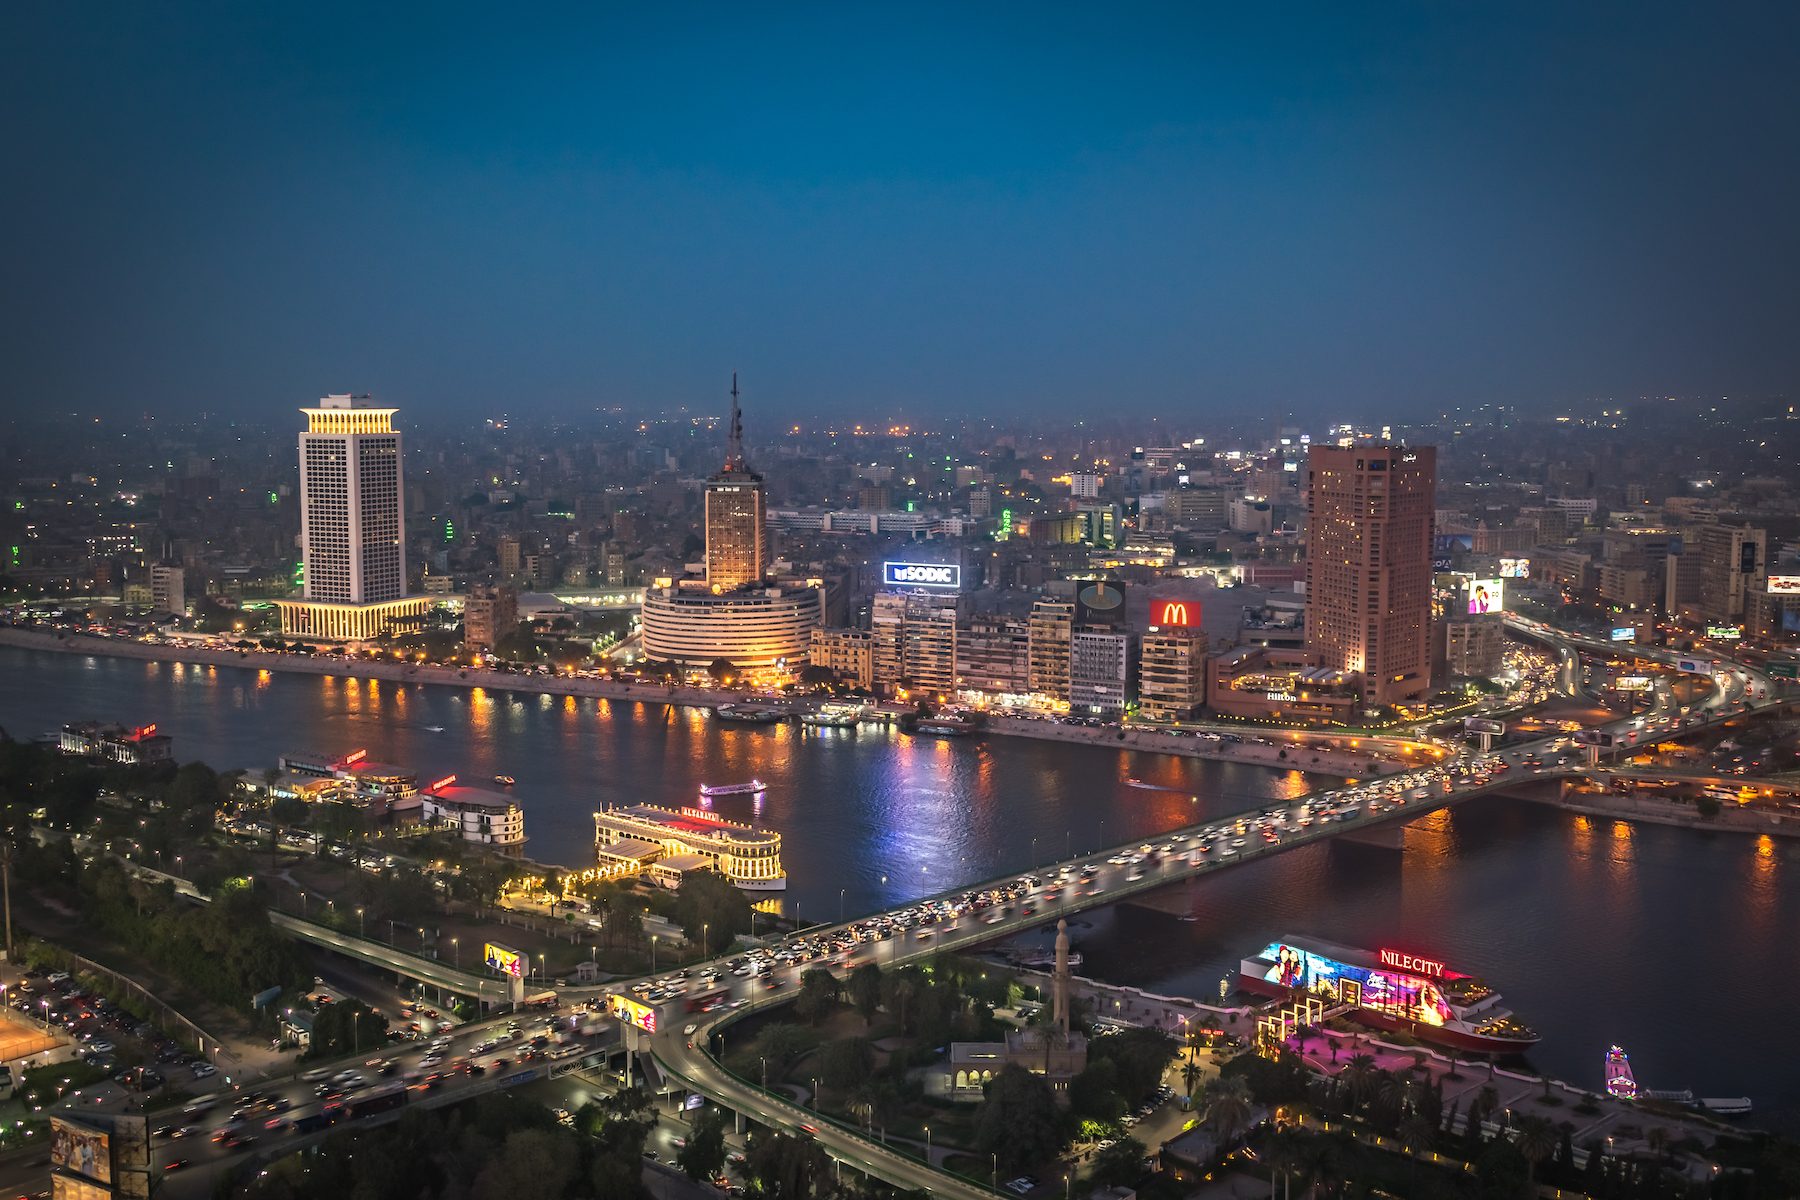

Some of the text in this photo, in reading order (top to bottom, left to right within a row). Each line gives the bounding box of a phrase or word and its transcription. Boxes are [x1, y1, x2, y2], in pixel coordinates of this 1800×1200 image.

[906, 566, 952, 583] SODIC
[1267, 692, 1297, 702] Hilton
[1381, 949, 1444, 977] NILE CITY
